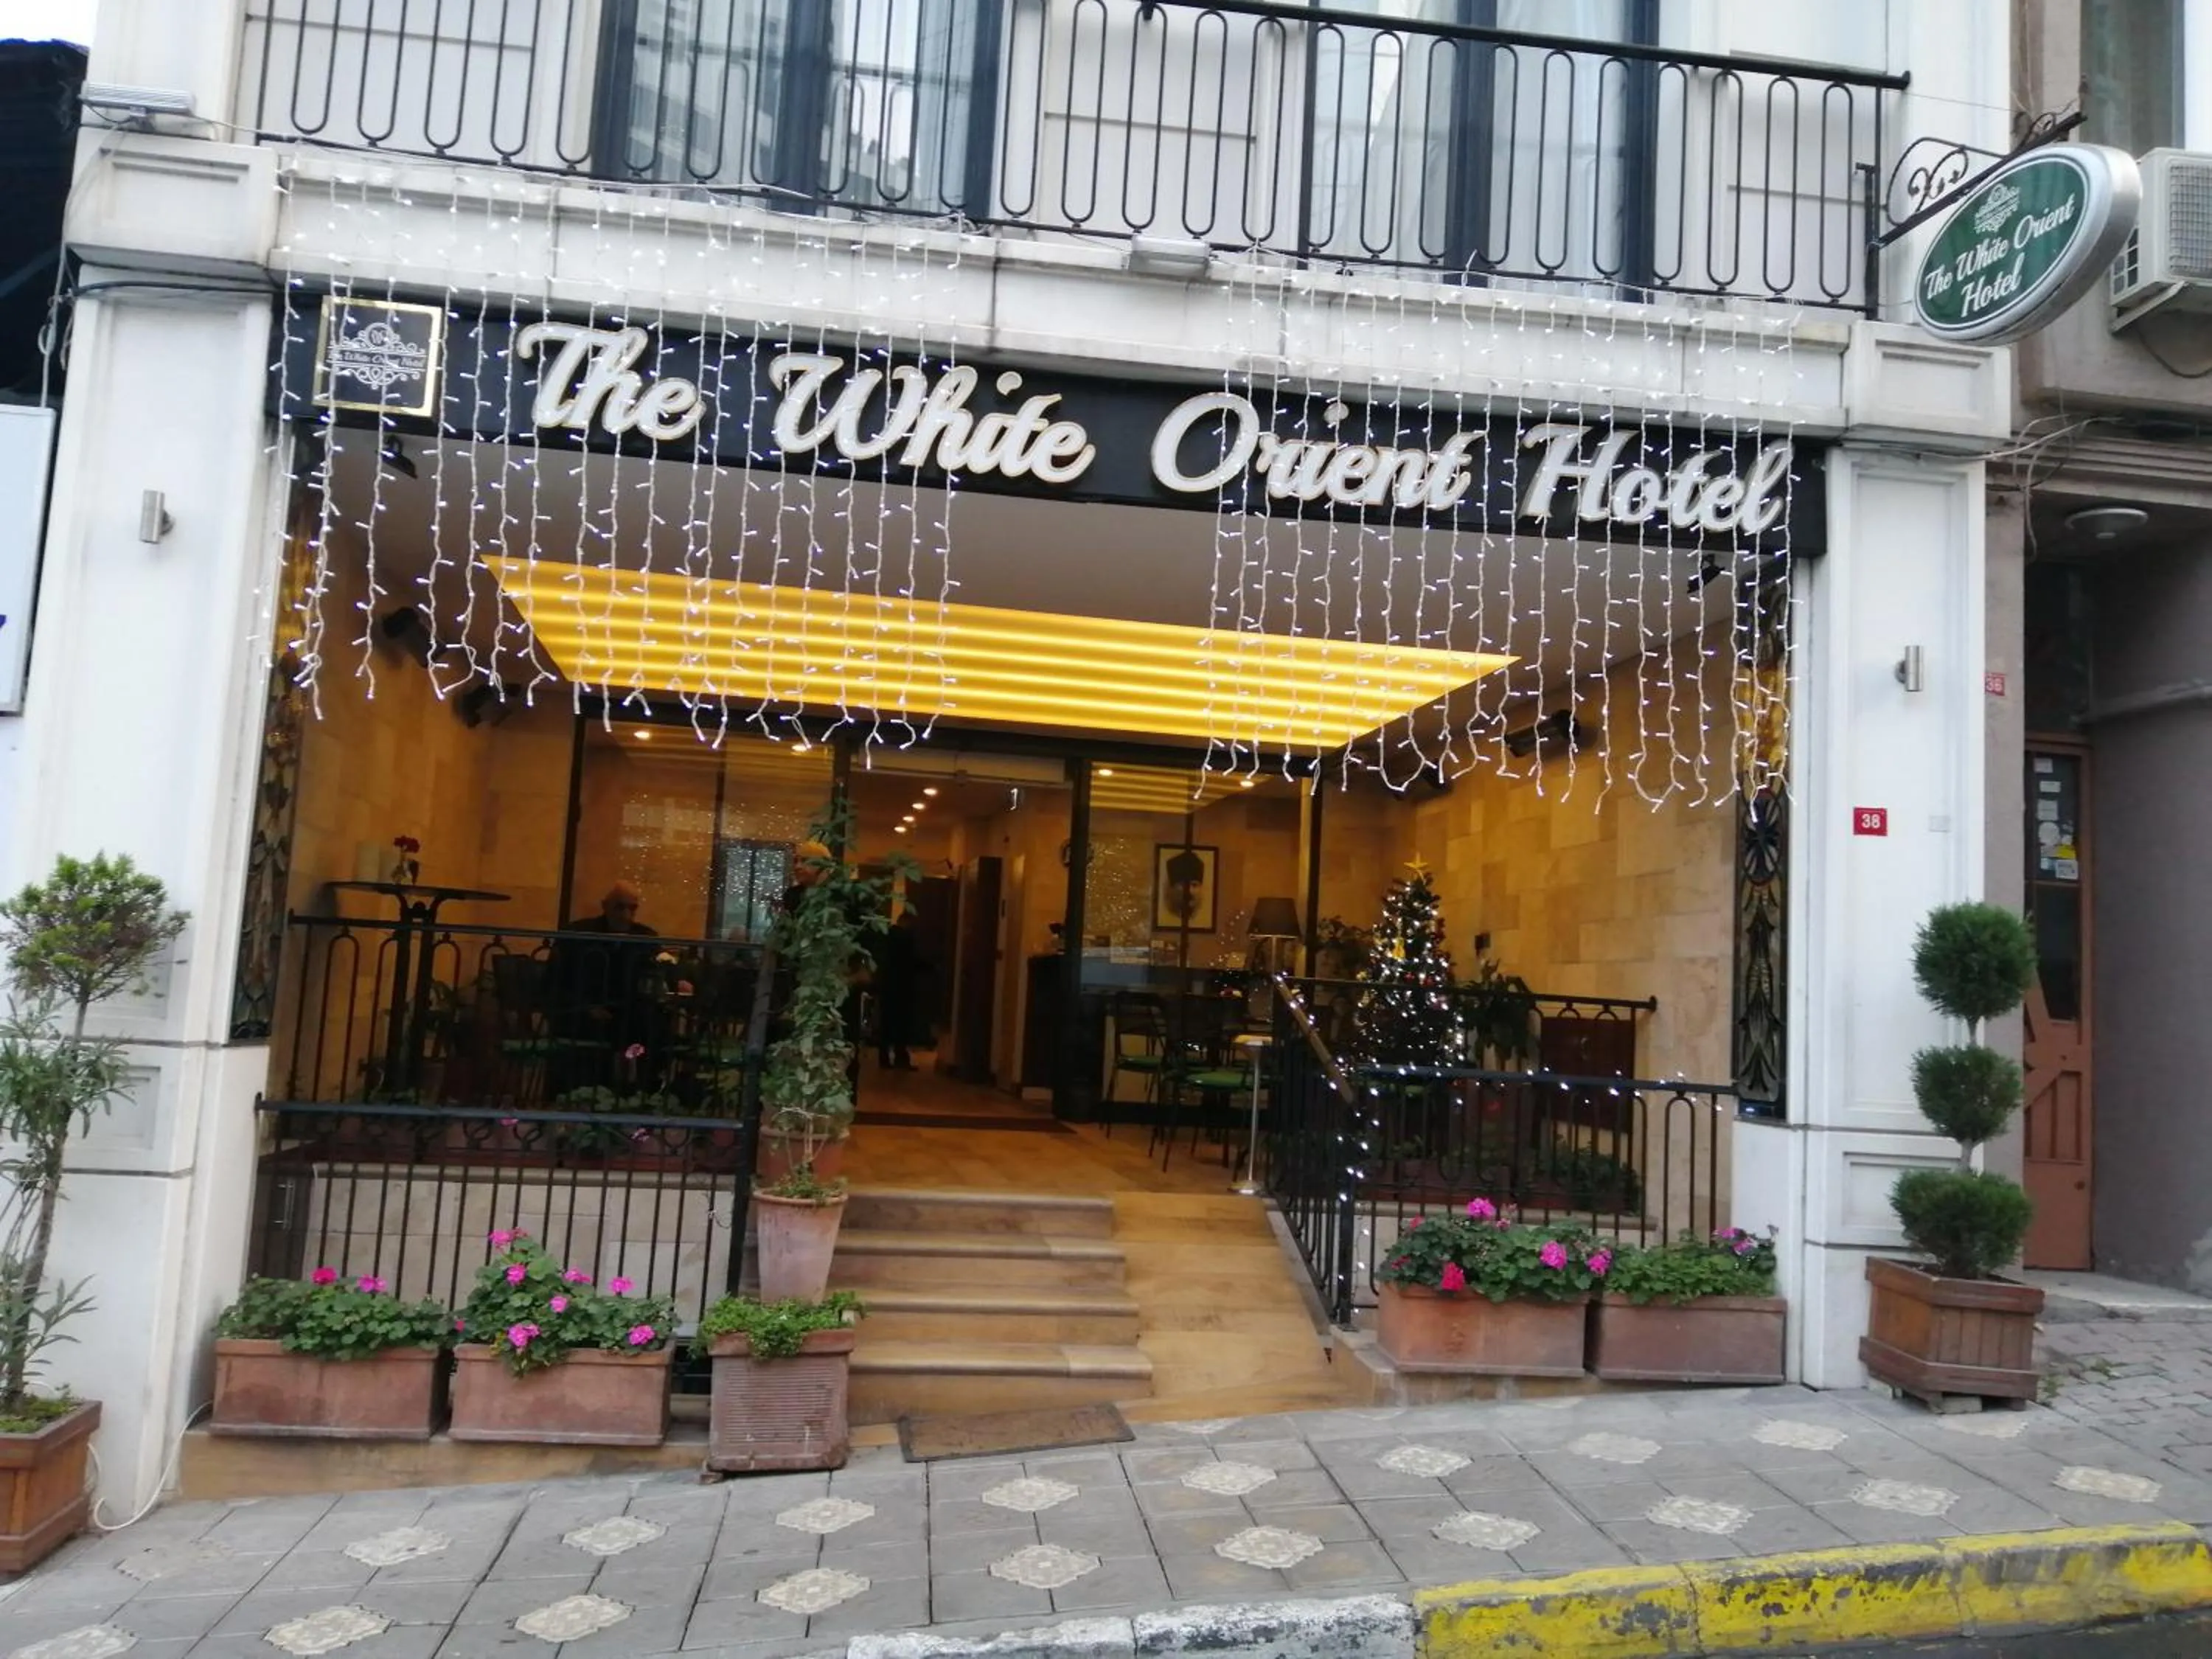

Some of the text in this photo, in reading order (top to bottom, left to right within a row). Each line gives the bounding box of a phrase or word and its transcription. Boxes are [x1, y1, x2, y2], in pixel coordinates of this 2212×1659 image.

[1925, 264, 1953, 299] The
[1956, 237, 2008, 281] White
[2014, 193, 2076, 249] Orient
[1961, 252, 2026, 318] Hotel
[518, 322, 1795, 534] The White Orient Hotel
[1861, 813, 1881, 829] 38
